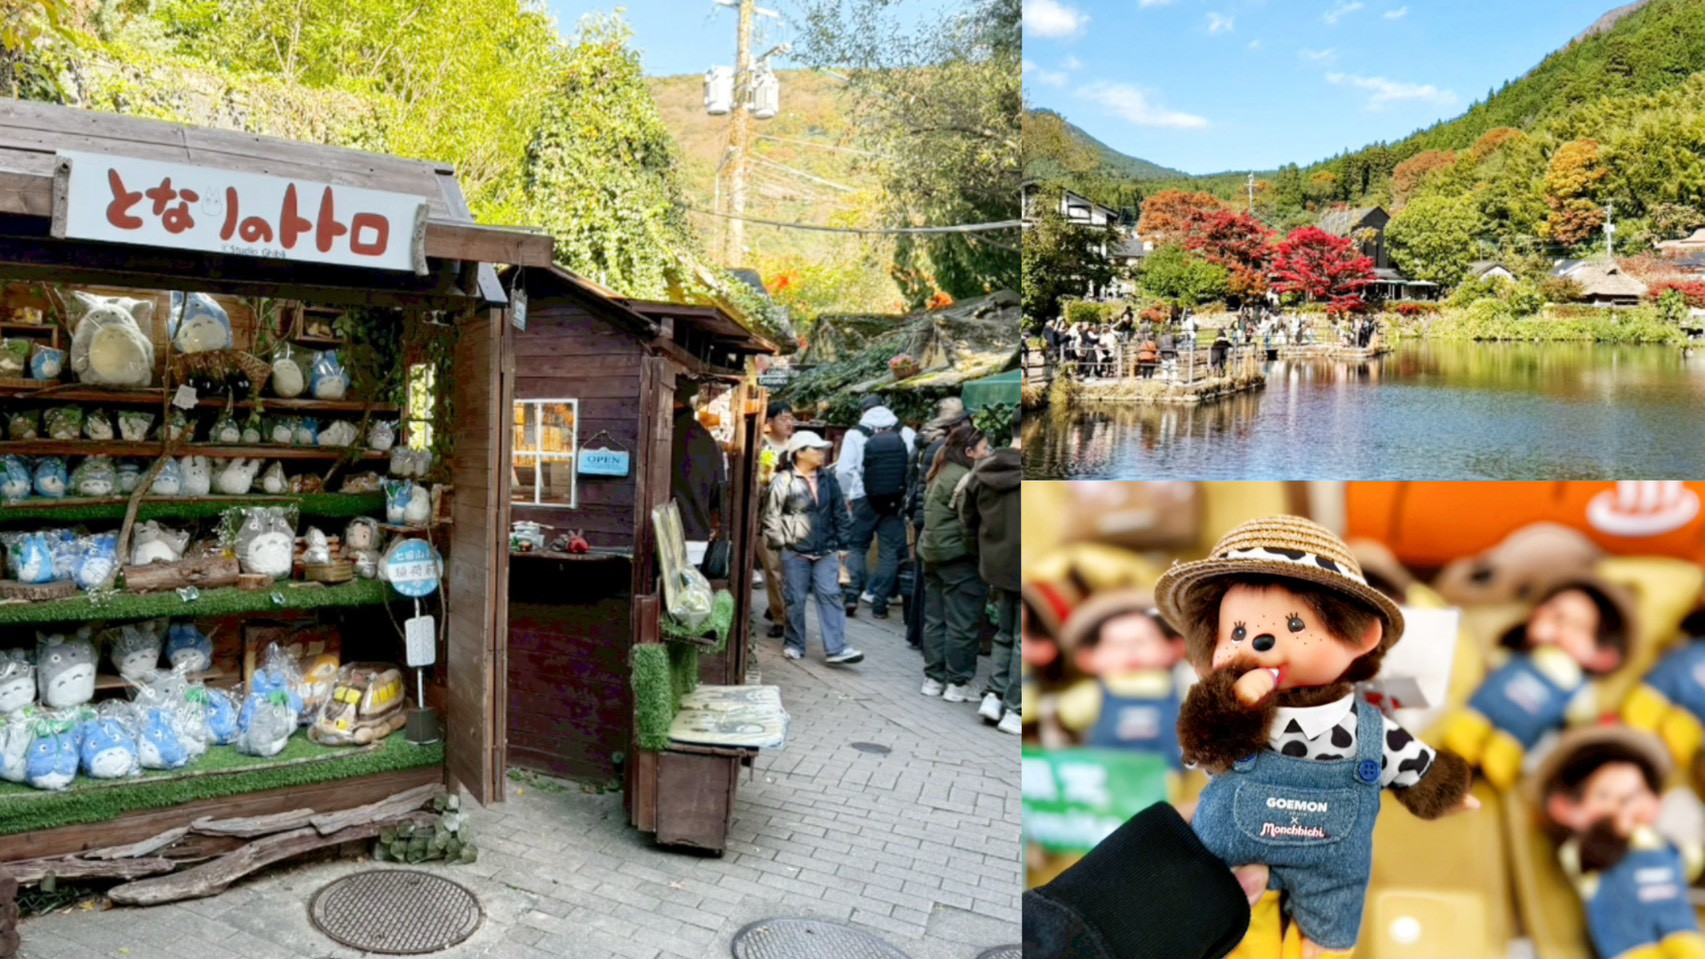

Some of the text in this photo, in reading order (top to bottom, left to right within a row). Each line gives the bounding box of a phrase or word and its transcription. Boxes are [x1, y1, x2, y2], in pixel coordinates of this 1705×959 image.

[106, 168, 389, 257] となりのトトロ
[587, 456, 620, 464] OPEN
[1266, 797, 1328, 812] GOEMON
[1260, 822, 1325, 838] Monchhichi
